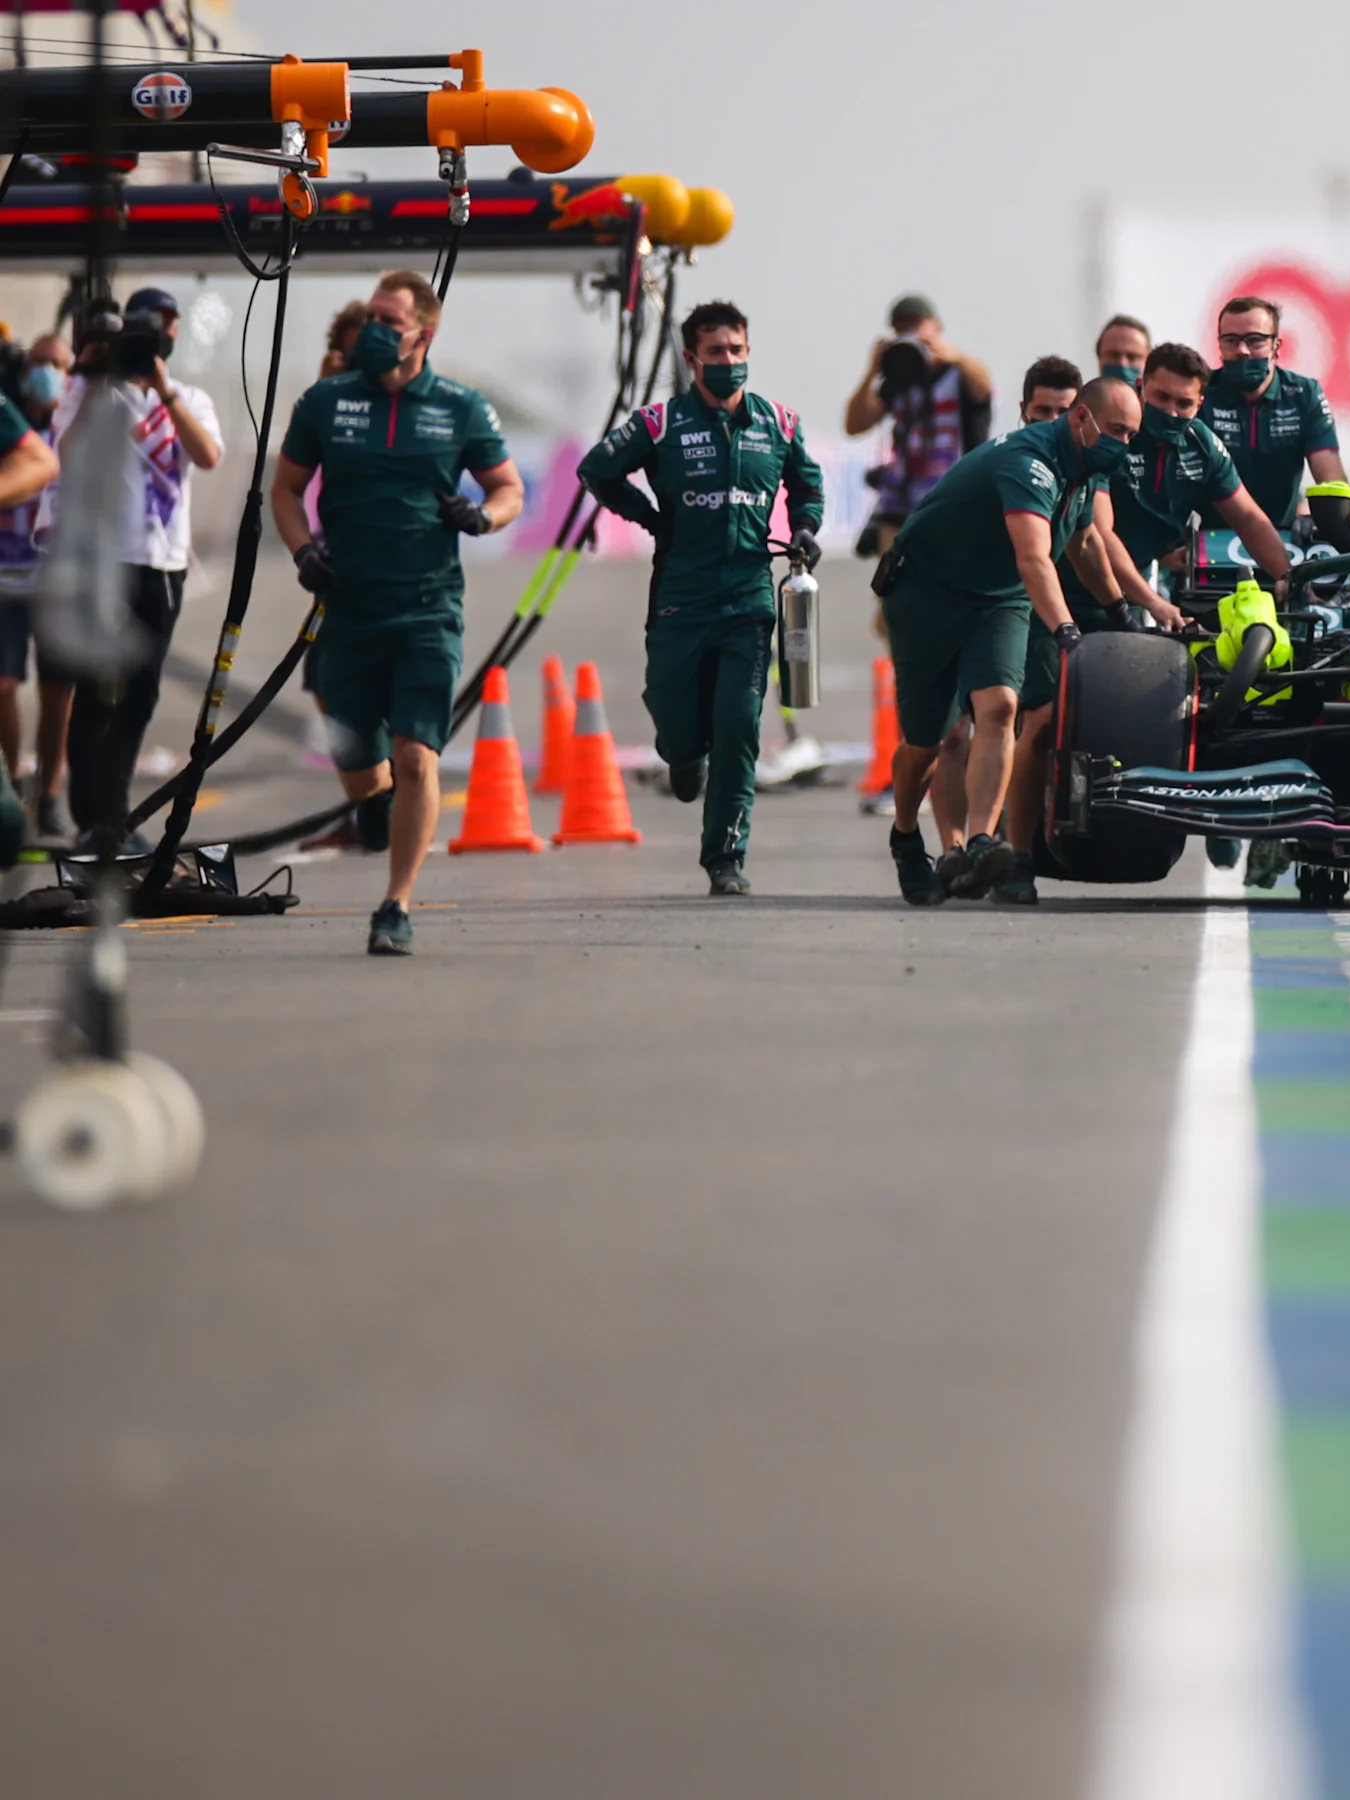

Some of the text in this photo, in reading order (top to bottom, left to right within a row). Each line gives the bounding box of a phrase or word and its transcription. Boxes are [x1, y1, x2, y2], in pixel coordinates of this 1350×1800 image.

[337, 399, 371, 413] BWT
[681, 431, 711, 446] BWT
[684, 446, 716, 459] JCB
[682, 487, 767, 509] Cognizant
[1139, 783, 1307, 799] ASTON MARTIN
